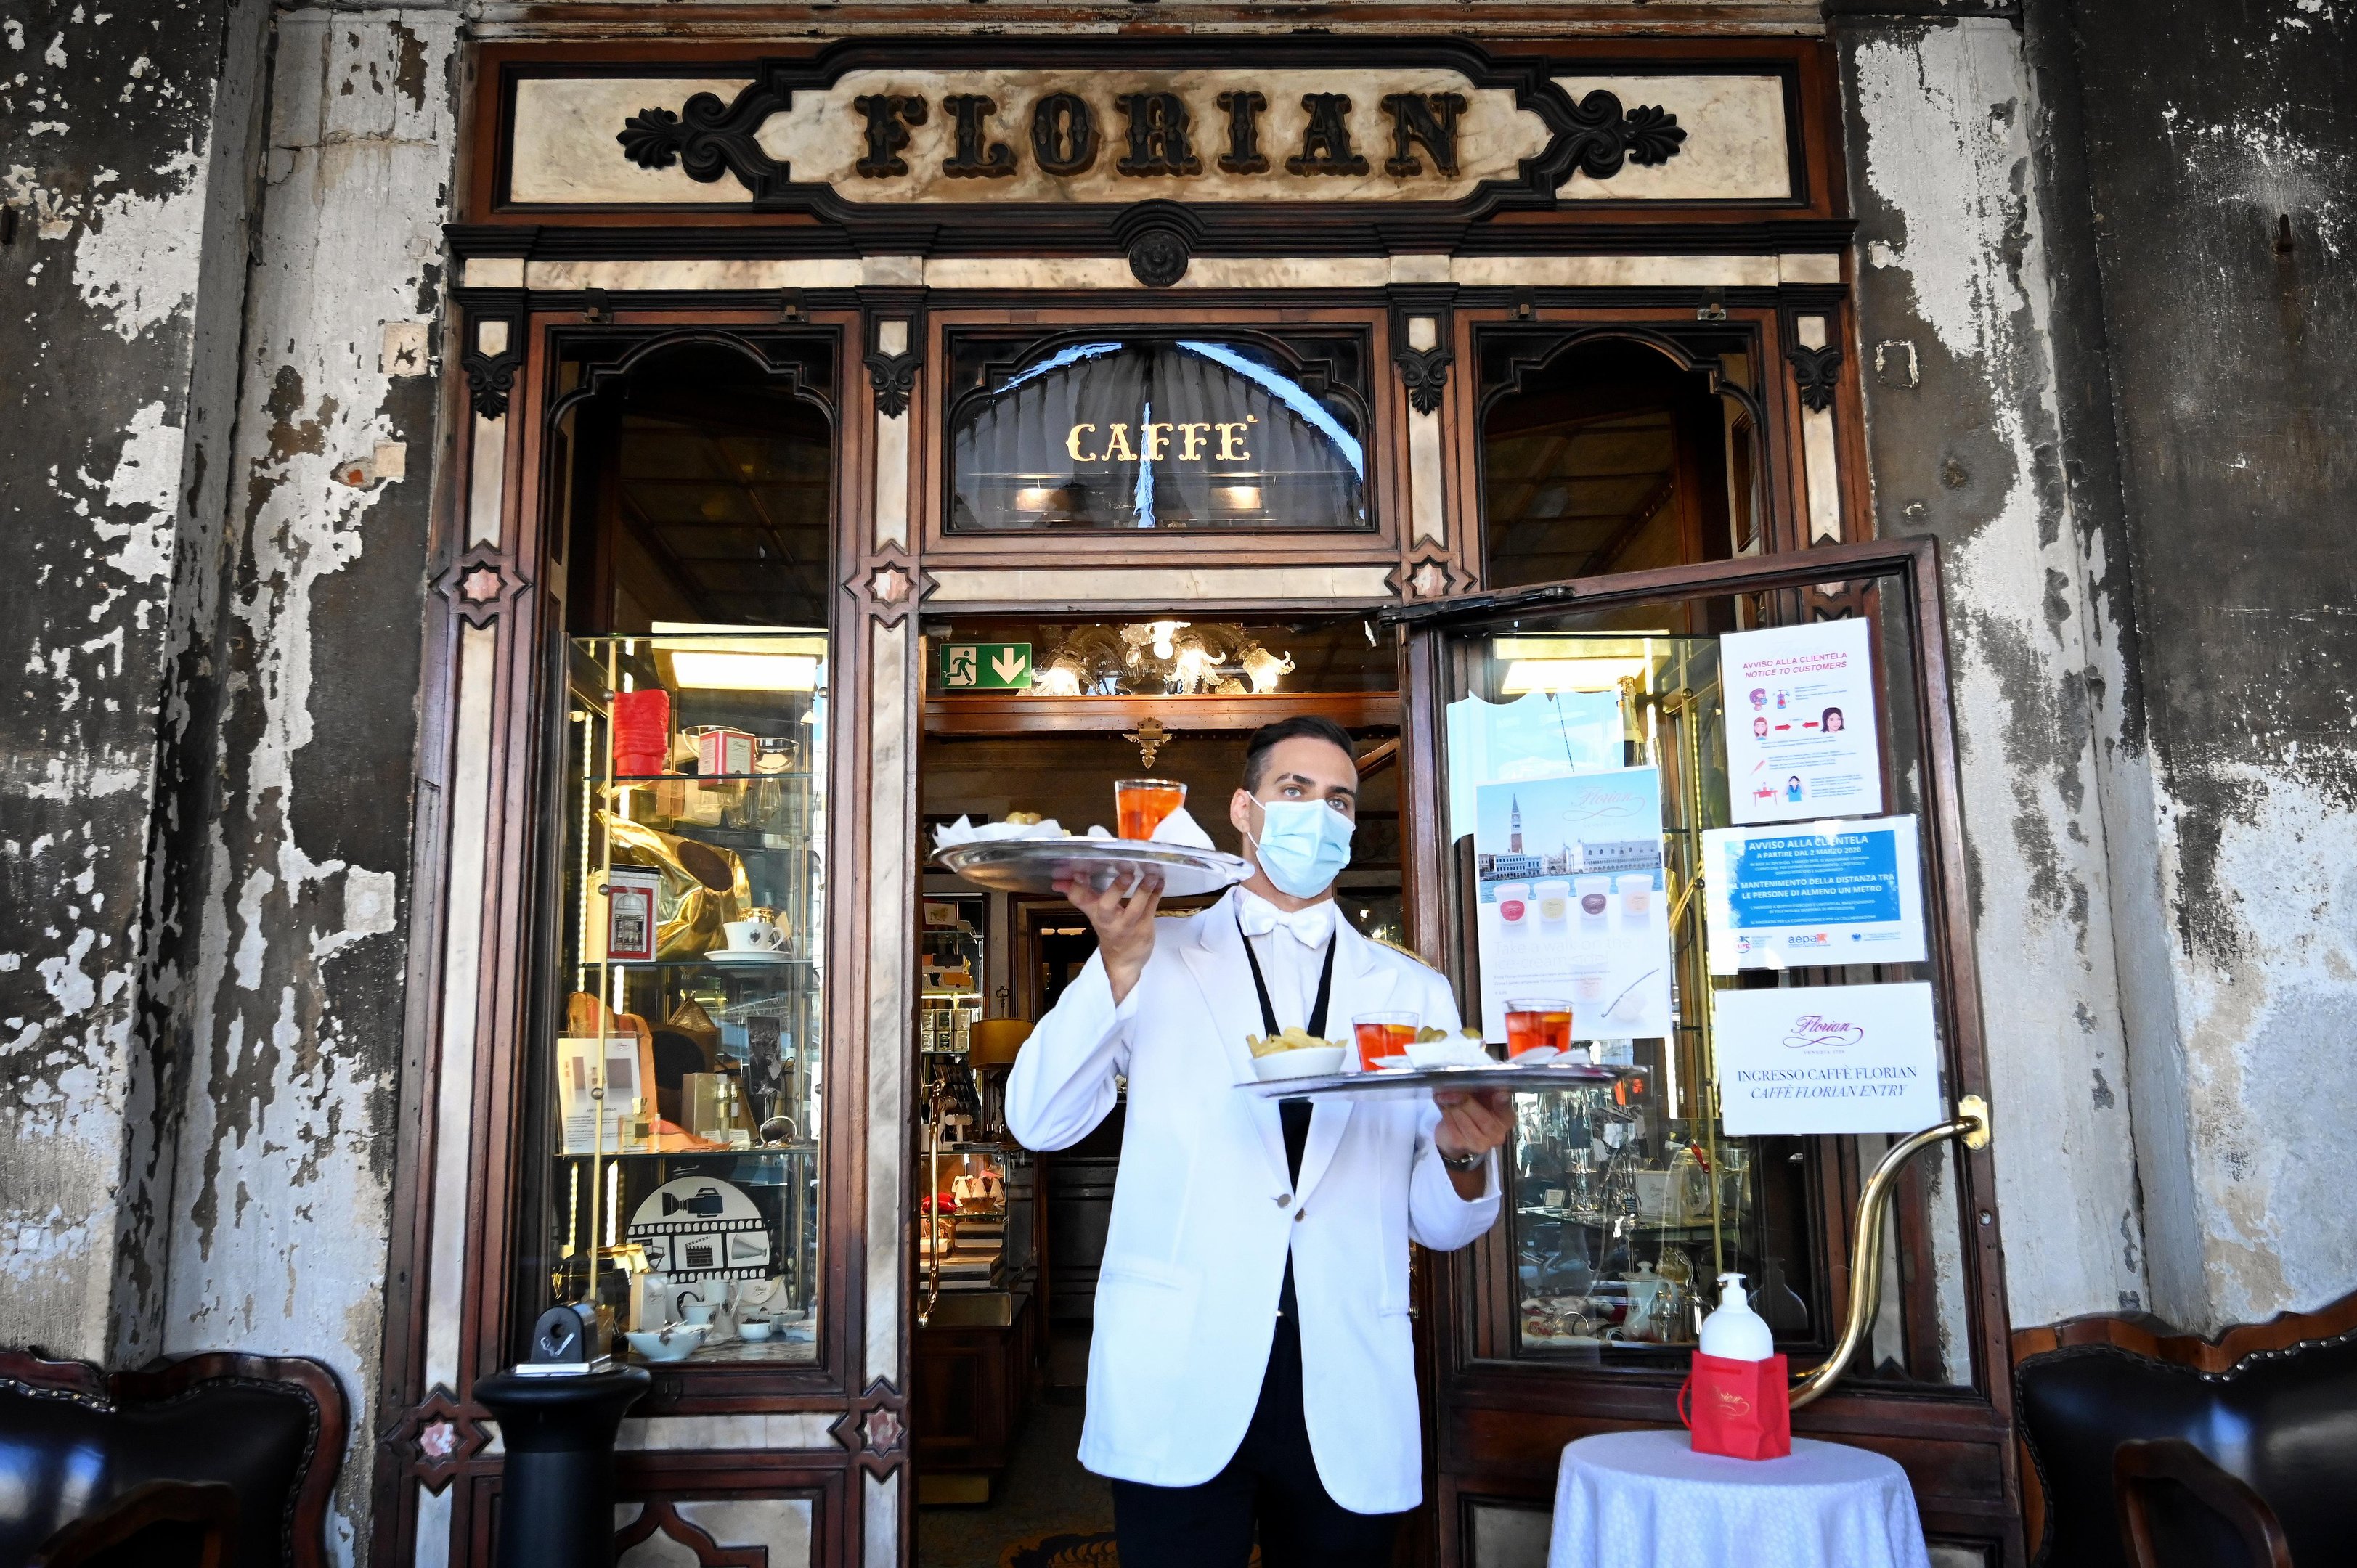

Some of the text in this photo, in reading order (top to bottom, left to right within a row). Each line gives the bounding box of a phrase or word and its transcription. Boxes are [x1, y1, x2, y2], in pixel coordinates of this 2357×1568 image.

[852, 89, 1468, 179] FLORIAN
[1743, 660, 1773, 669] AVVISO
[1799, 652, 1847, 663] CLIENTELA
[1745, 669, 1777, 678] NOTICE
[1793, 661, 1847, 674] CUSTOMERS
[1749, 840, 1785, 851] AVVISO
[1787, 838, 1813, 848] ALLA
[1764, 850, 1793, 859] PARTIRE
[1741, 878, 1807, 889] MANTENIMENTO
[1836, 875, 1877, 883] DISTANZA
[1752, 889, 1789, 899] PERSONE
[1801, 887, 1836, 897] ALMENO
[1852, 885, 1883, 894] METRO
[1493, 940, 1528, 955] Take
[1543, 937, 1576, 952] walk
[1581, 940, 1601, 950] on
[1606, 936, 1632, 950] the
[1786, 1015, 1862, 1040] Florian
[1738, 1065, 1917, 1082] INGRESSO CAFFÈ FLORIAN
[1751, 1084, 1908, 1099] CAFFÈ FLORIAN ENTRY
